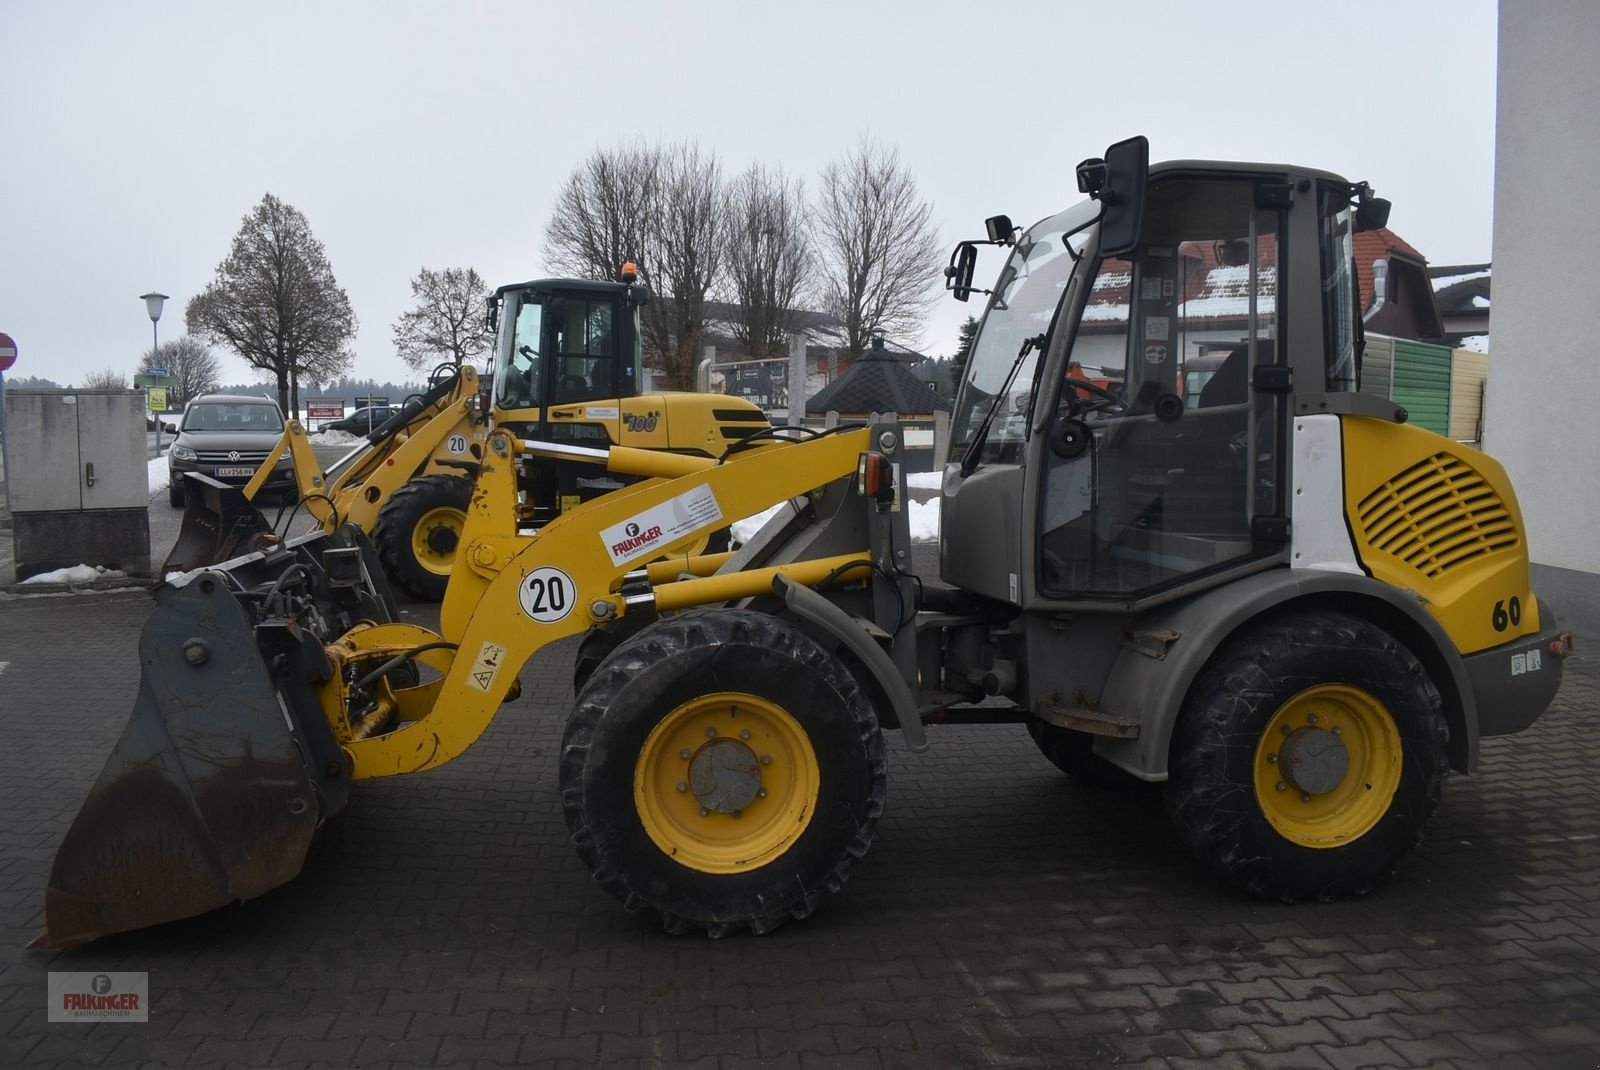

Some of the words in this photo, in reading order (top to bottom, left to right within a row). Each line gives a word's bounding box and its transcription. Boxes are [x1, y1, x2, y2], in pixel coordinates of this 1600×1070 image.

[451, 438, 465, 452] 20
[611, 525, 663, 557] FALKINGER
[627, 524, 637, 537] F
[623, 539, 659, 558] BAUMASCHINEN
[529, 576, 565, 614] 20
[1492, 595, 1521, 633] 60
